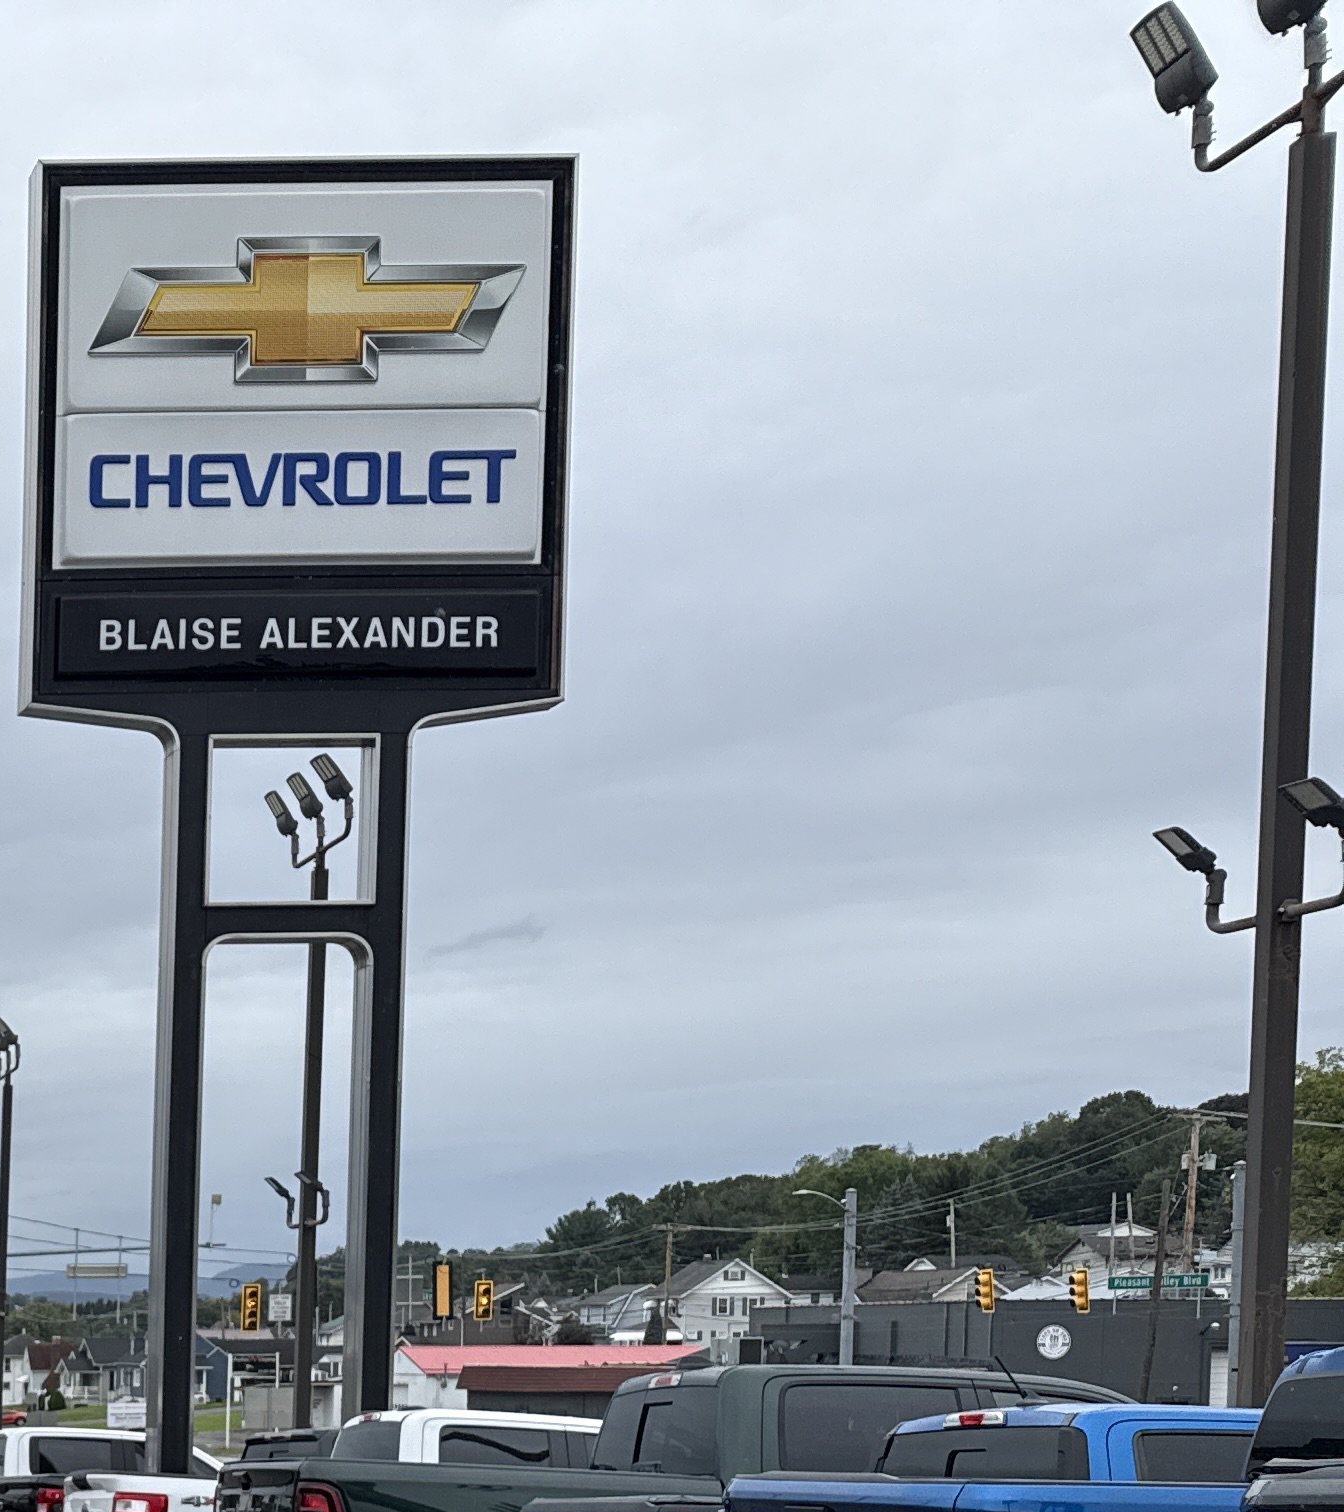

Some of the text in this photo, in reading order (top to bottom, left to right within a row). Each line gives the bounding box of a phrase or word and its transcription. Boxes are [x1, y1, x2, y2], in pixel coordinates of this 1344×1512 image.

[88, 448, 517, 509] CHEVROLET
[98, 615, 500, 651] BLAISE ALEXANDER
[1114, 1277, 1150, 1287] Pleasant
[1183, 1275, 1202, 1286] Blvd
